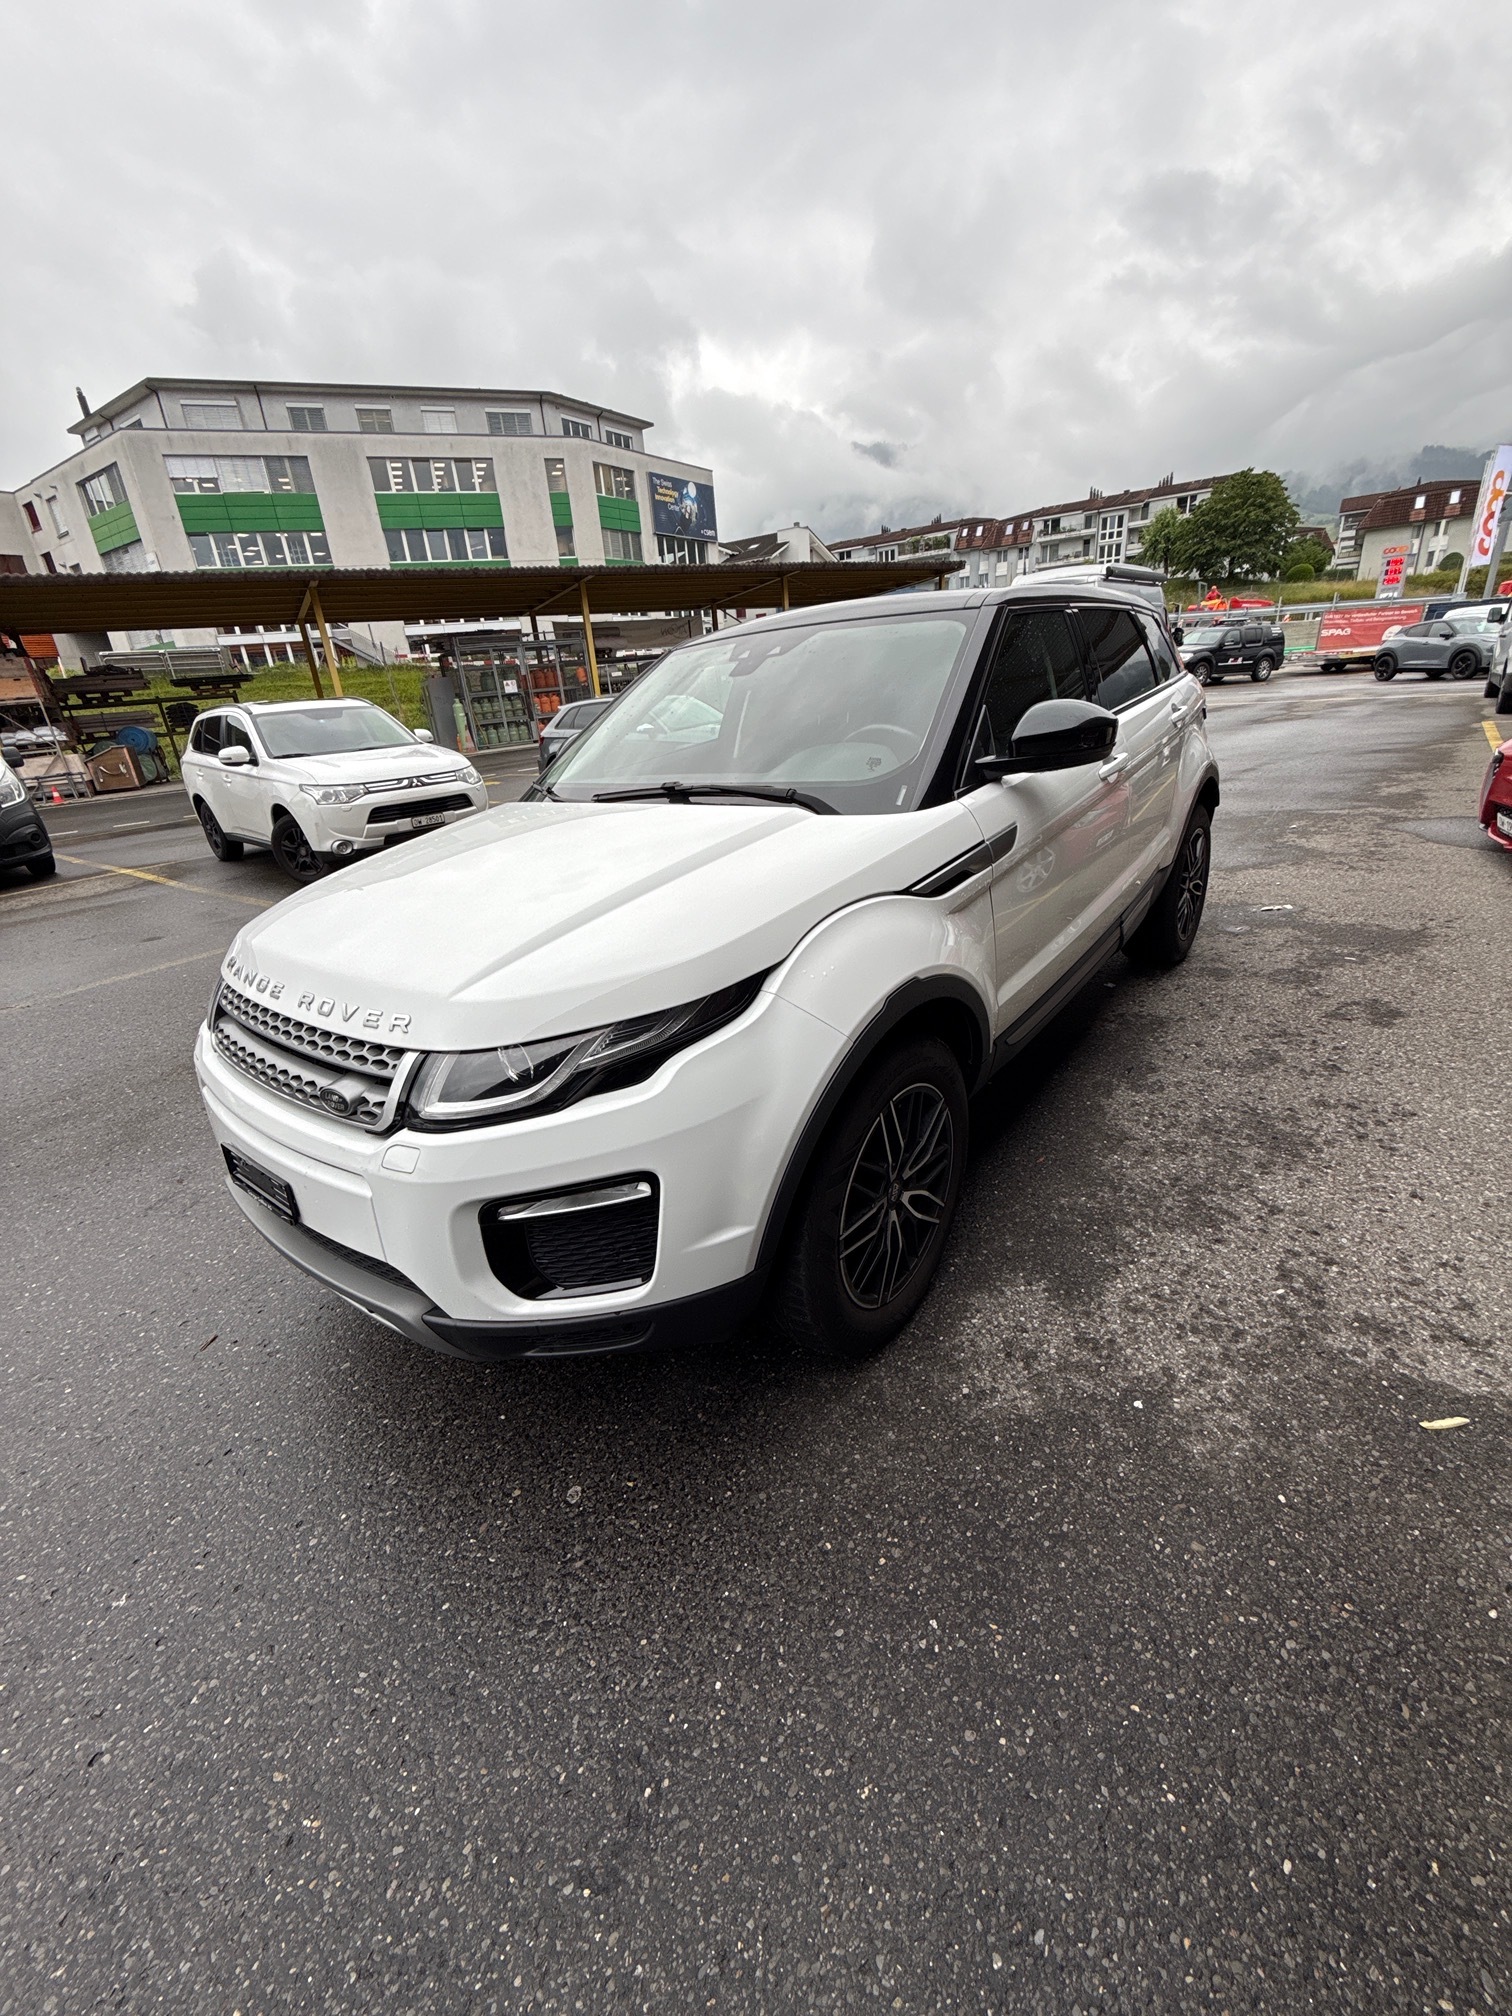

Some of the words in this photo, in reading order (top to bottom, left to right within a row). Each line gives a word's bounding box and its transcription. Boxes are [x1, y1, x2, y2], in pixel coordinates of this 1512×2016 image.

[656, 485, 679, 499] Technology
[654, 493, 676, 504] Innovation
[703, 529, 716, 537] csem
[1320, 627, 1352, 637] SPAG
[226, 955, 285, 1000] RANGE
[297, 991, 412, 1034] ROVER
